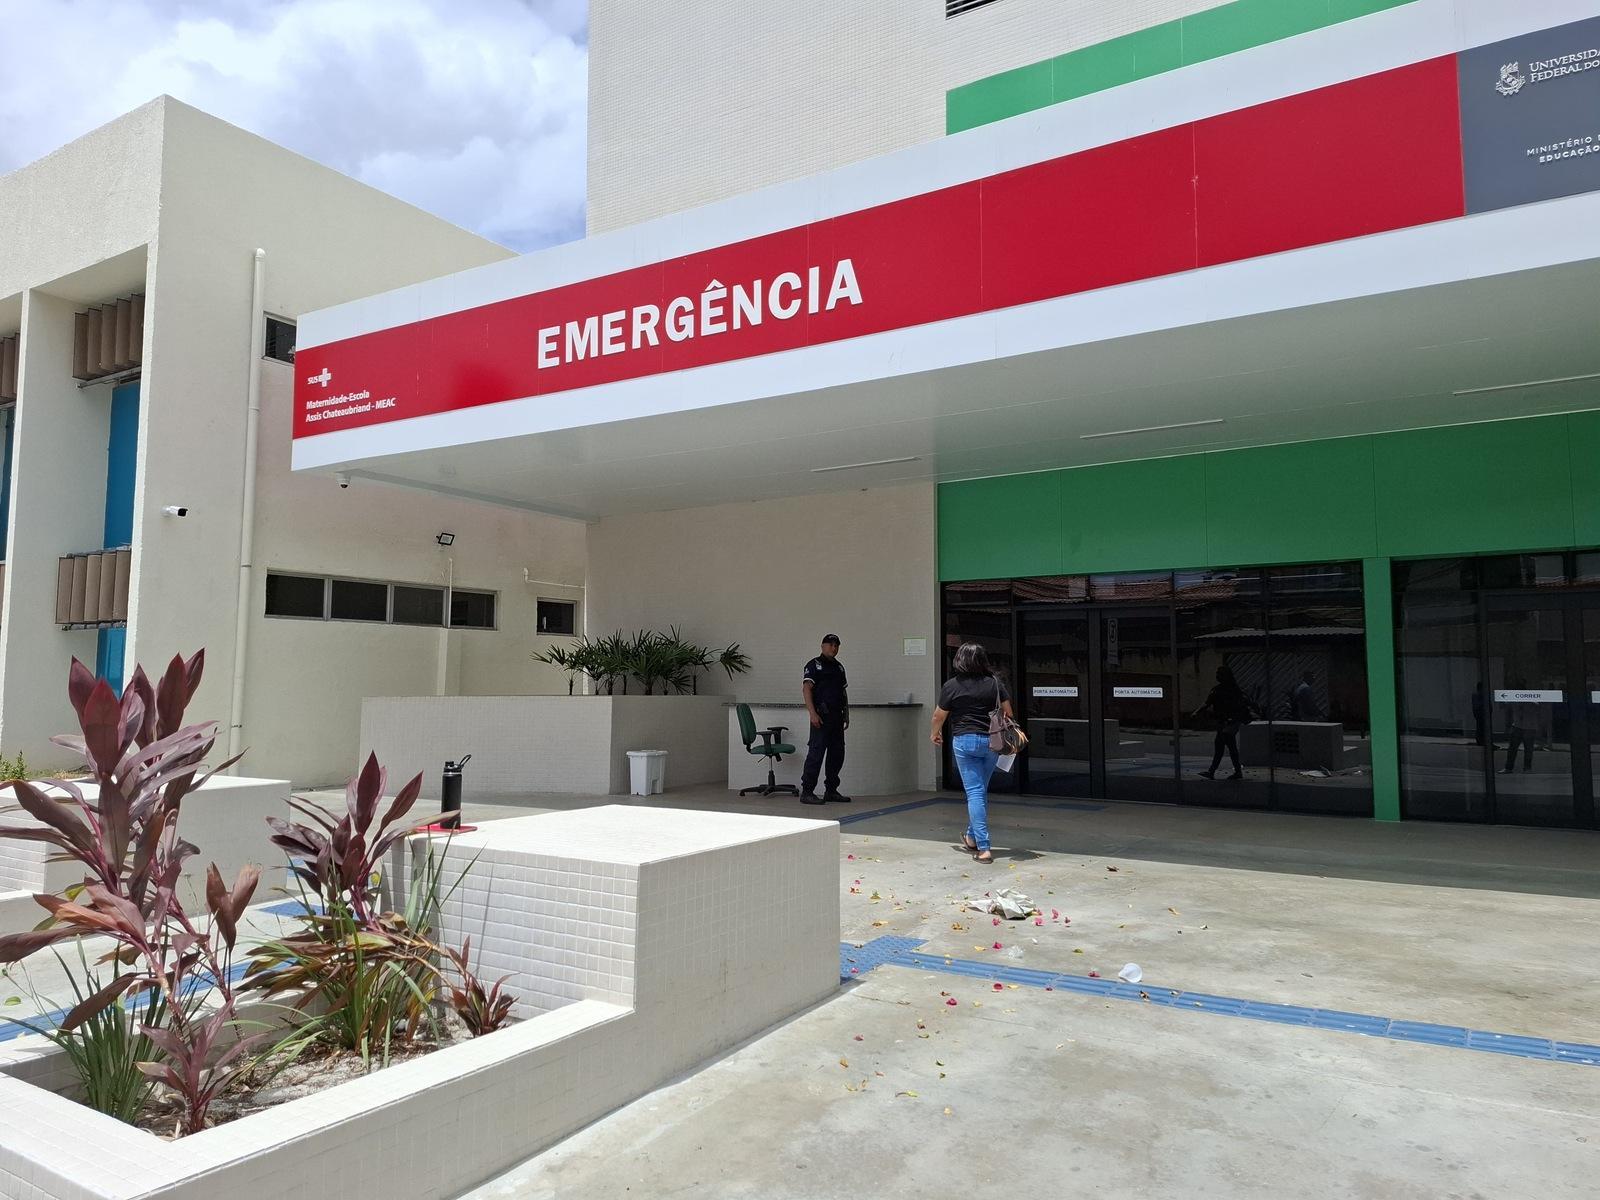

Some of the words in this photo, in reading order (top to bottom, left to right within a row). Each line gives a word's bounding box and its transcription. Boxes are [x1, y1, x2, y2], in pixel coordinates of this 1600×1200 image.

[1529, 49, 1600, 72] UNIVERSID
[1530, 63, 1582, 83] FEDERAL
[1584, 60, 1600, 70] DO
[1527, 136, 1592, 156] MINISTÉRIO
[1539, 145, 1600, 163] EDUCAÇÃO
[537, 258, 863, 369] EMERGÊNCIA
[305, 412, 322, 423] Assis
[322, 402, 371, 419] Chateaubriand
[375, 397, 396, 410] MEAC
[306, 390, 370, 410] Maternidade-Escola
